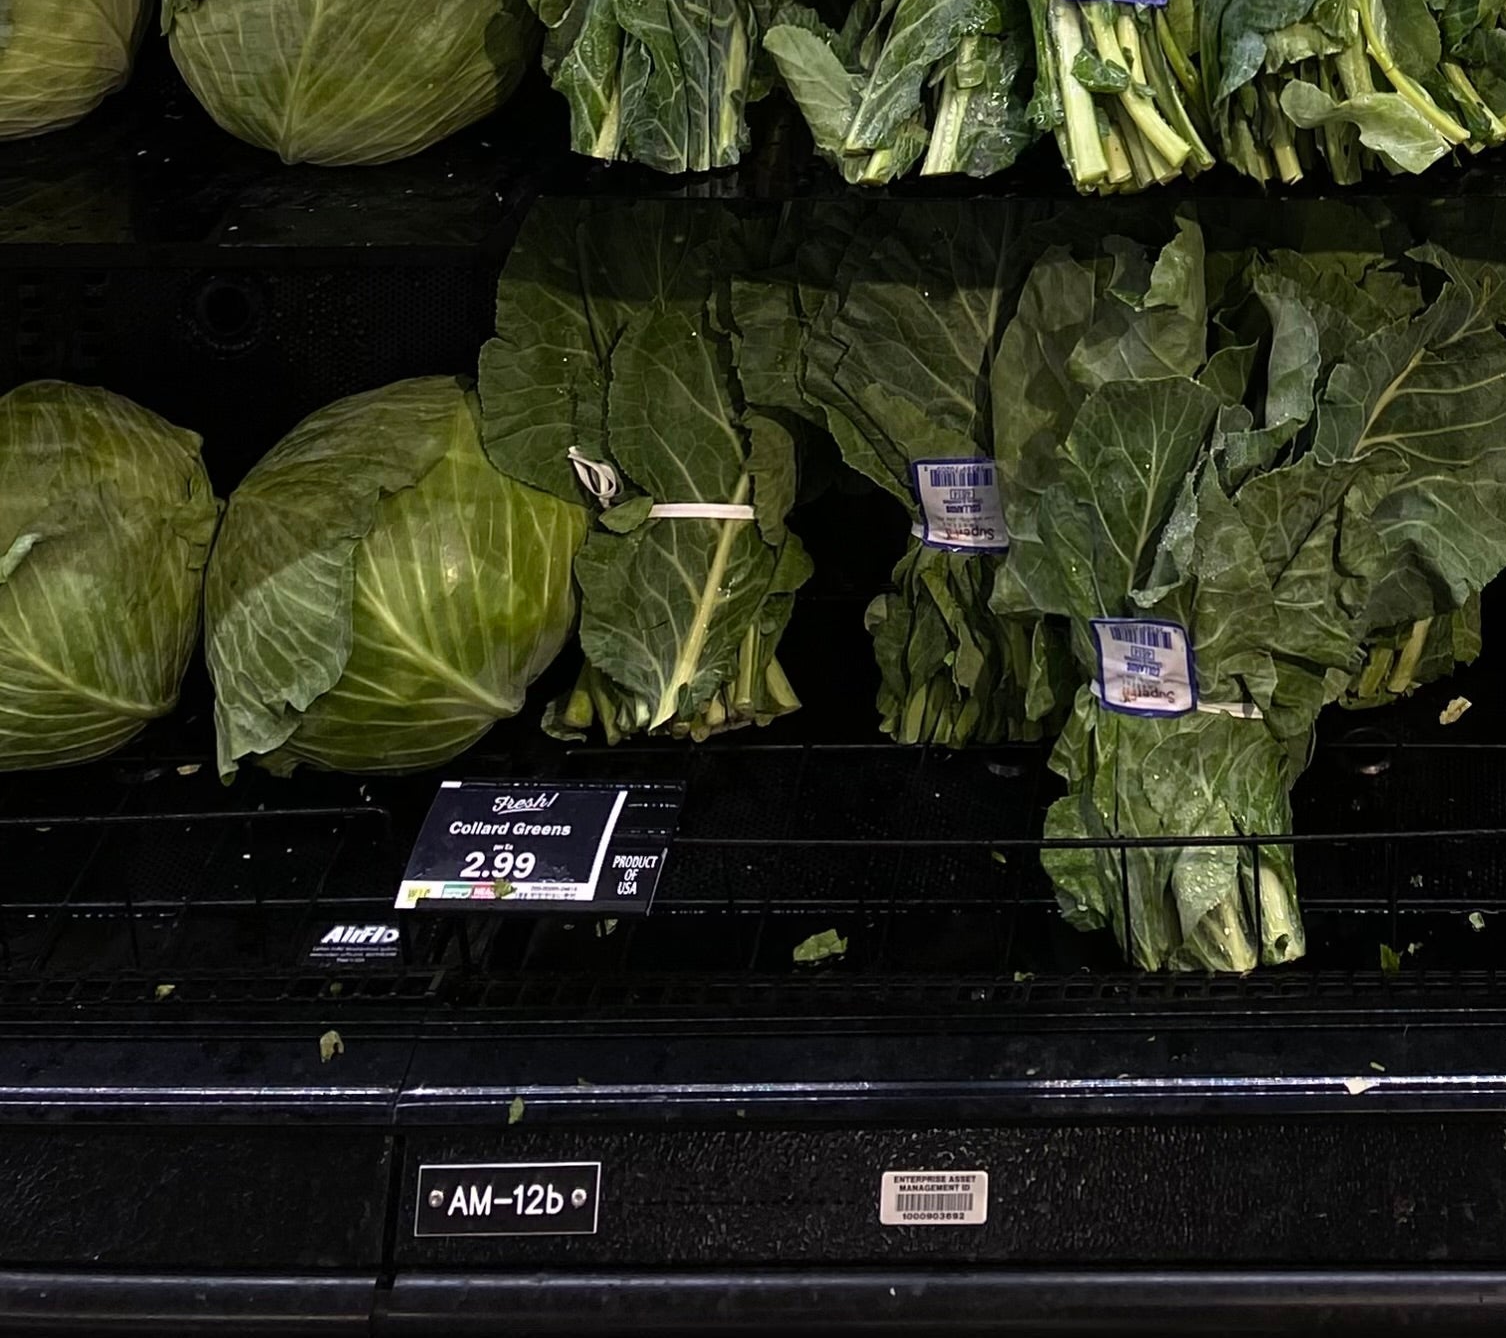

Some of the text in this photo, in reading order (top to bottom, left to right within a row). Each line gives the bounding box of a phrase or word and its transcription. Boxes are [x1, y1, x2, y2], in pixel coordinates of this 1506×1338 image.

[493, 793, 559, 812] Fresh!
[450, 822, 571, 835] Collard Greens
[460, 851, 535, 878] 2.99
[612, 855, 658, 868] PRODUCT
[624, 869, 638, 881] OF
[617, 882, 638, 895] USA
[321, 926, 399, 943] AirFlo
[893, 1175, 976, 1184] ENTERPRISE ASSET
[899, 1184, 959, 1192] MANAGEMENT
[447, 1184, 564, 1216] AM-12b
